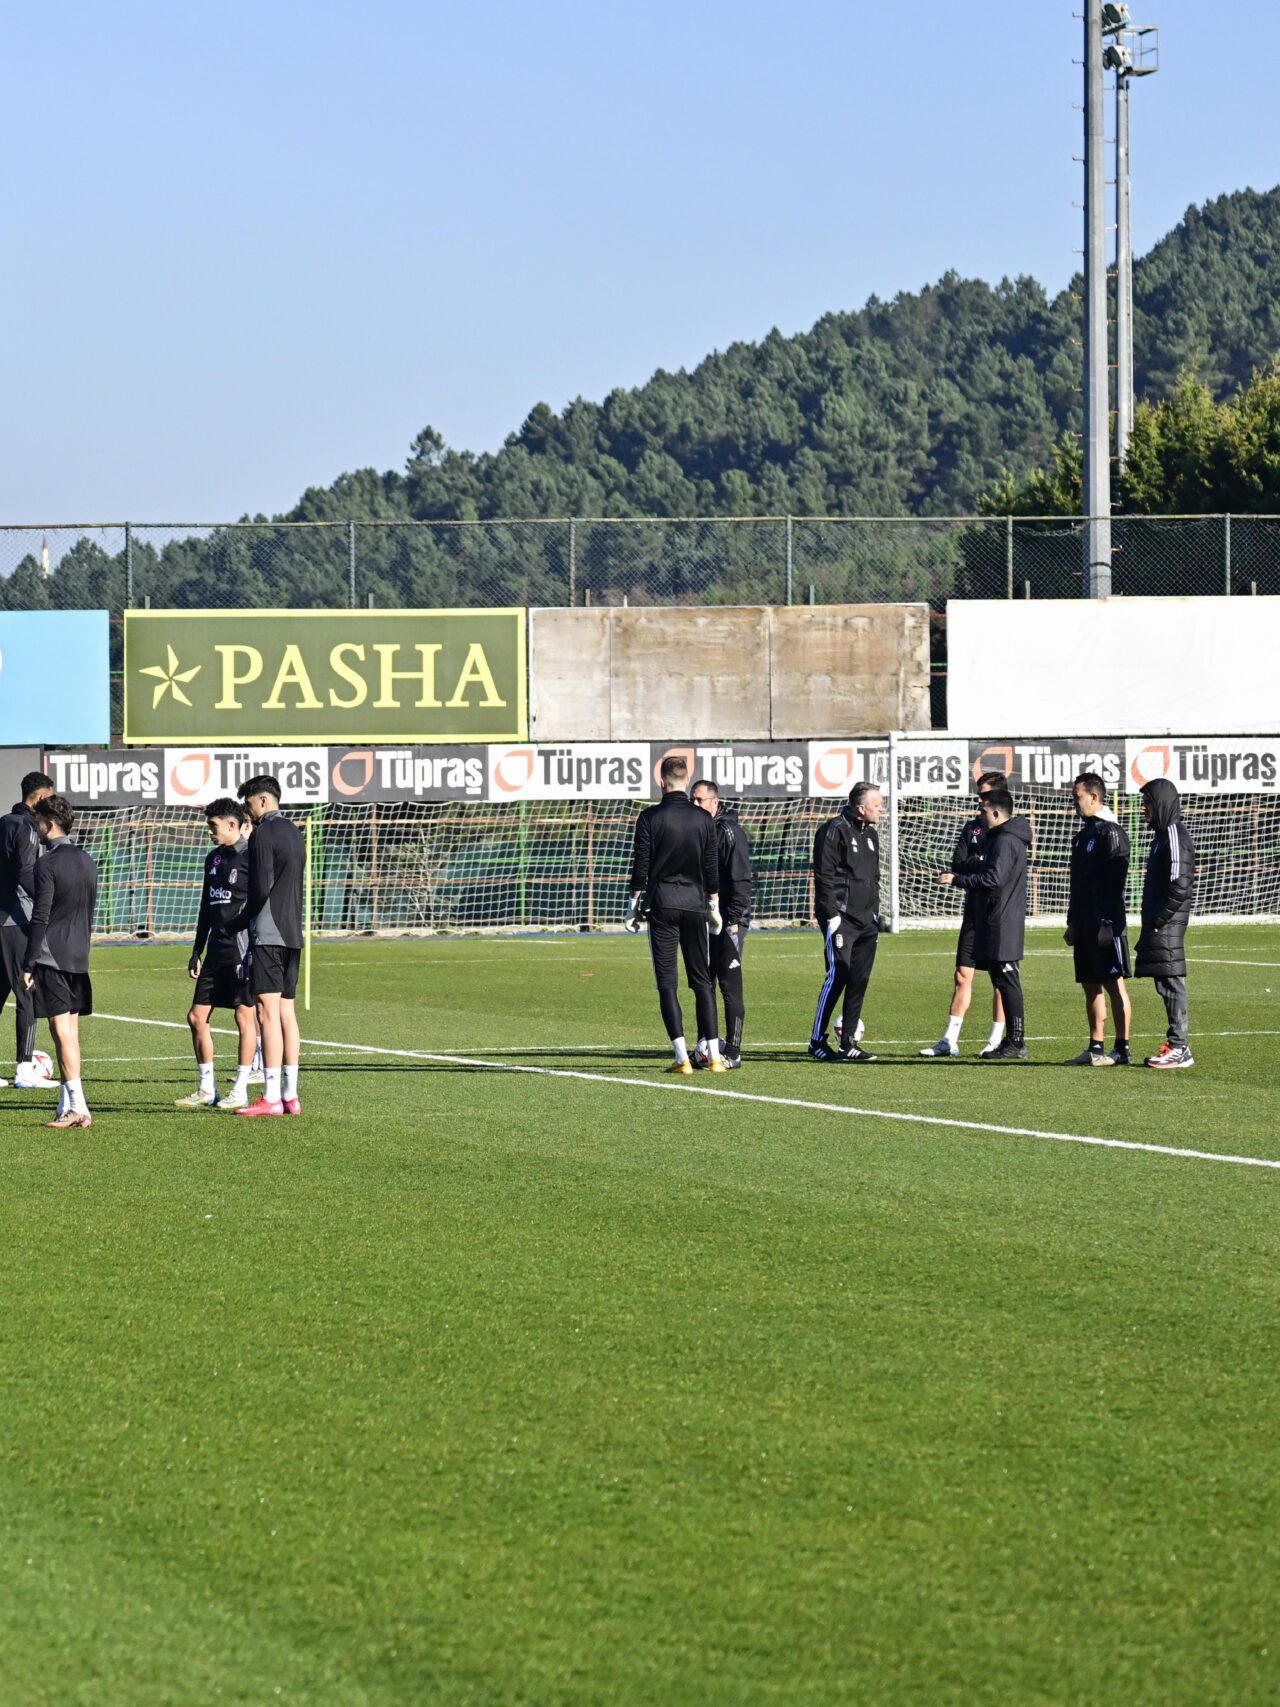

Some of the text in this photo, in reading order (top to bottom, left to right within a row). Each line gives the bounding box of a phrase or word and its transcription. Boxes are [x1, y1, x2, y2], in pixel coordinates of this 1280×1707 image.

[214, 643, 507, 709] PASHA
[50, 755, 158, 799] Tüpraş
[375, 751, 483, 795] Tüpraş
[537, 749, 643, 791] Tüpraş
[697, 747, 803, 792] Tüpraş
[1173, 745, 1277, 787] Tüpraş
[210, 885, 232, 899] beko
